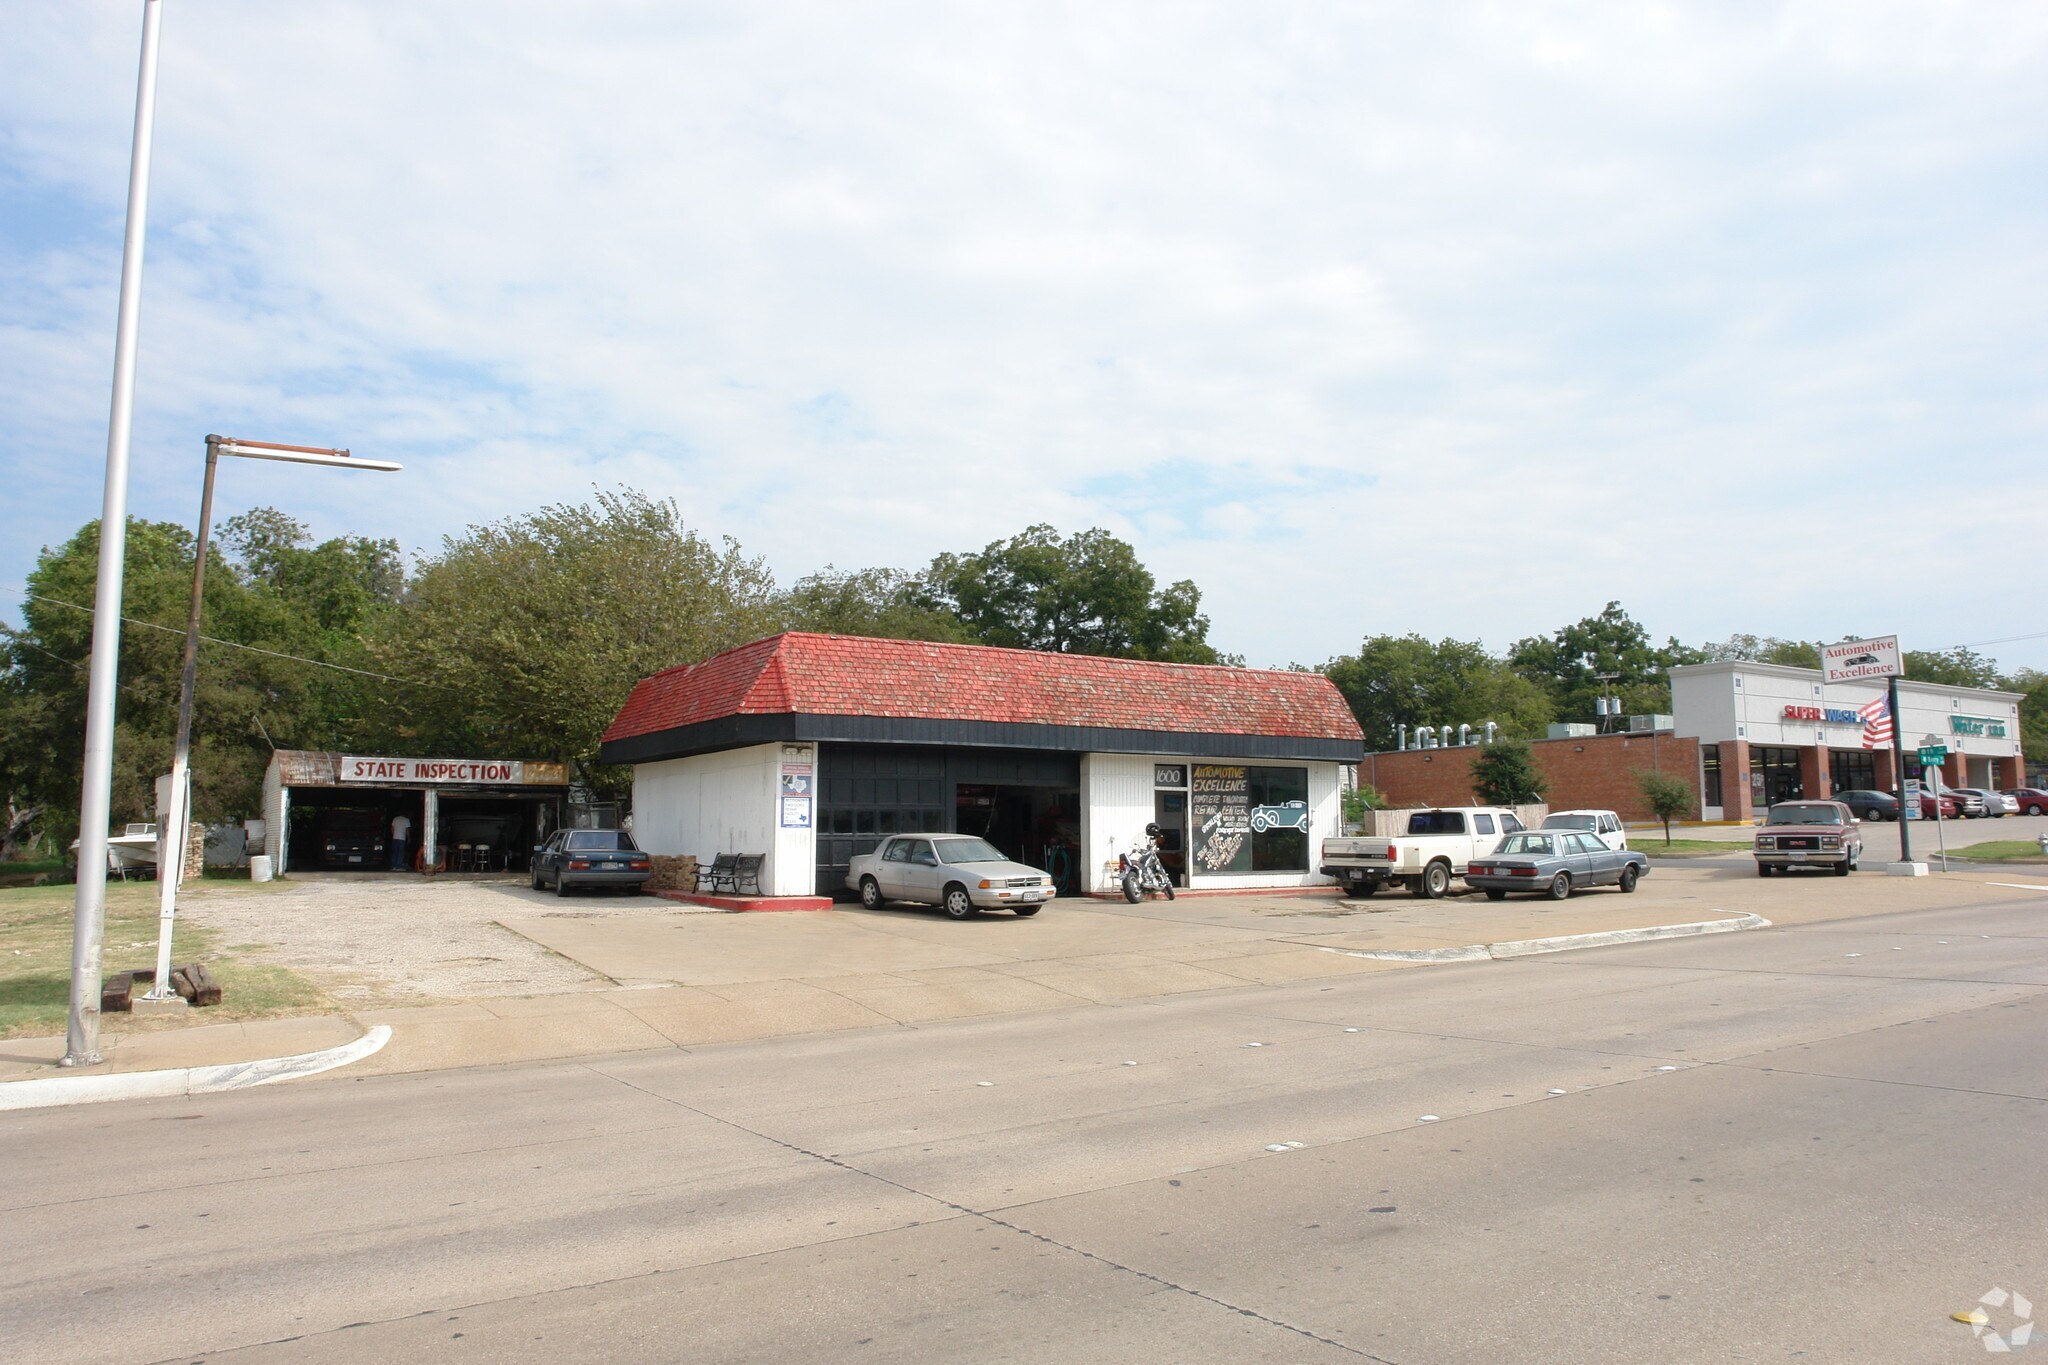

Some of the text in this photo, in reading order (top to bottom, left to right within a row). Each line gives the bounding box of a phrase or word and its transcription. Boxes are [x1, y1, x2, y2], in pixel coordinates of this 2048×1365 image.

[1825, 641, 1894, 658] Automotive
[1830, 664, 1894, 680] Excellence
[1785, 705, 1820, 720] SUPER
[1824, 709, 1857, 723] WASH
[1950, 715, 1983, 735] Water
[354, 761, 406, 778] STATE
[415, 763, 511, 780] INSPECTION
[1156, 769, 1180, 783] 1600
[1194, 766, 1246, 779] AUTOMOTIVE
[1193, 779, 1248, 792] EXCELLENCE
[1194, 805, 1249, 816] REPAIR CENTER
